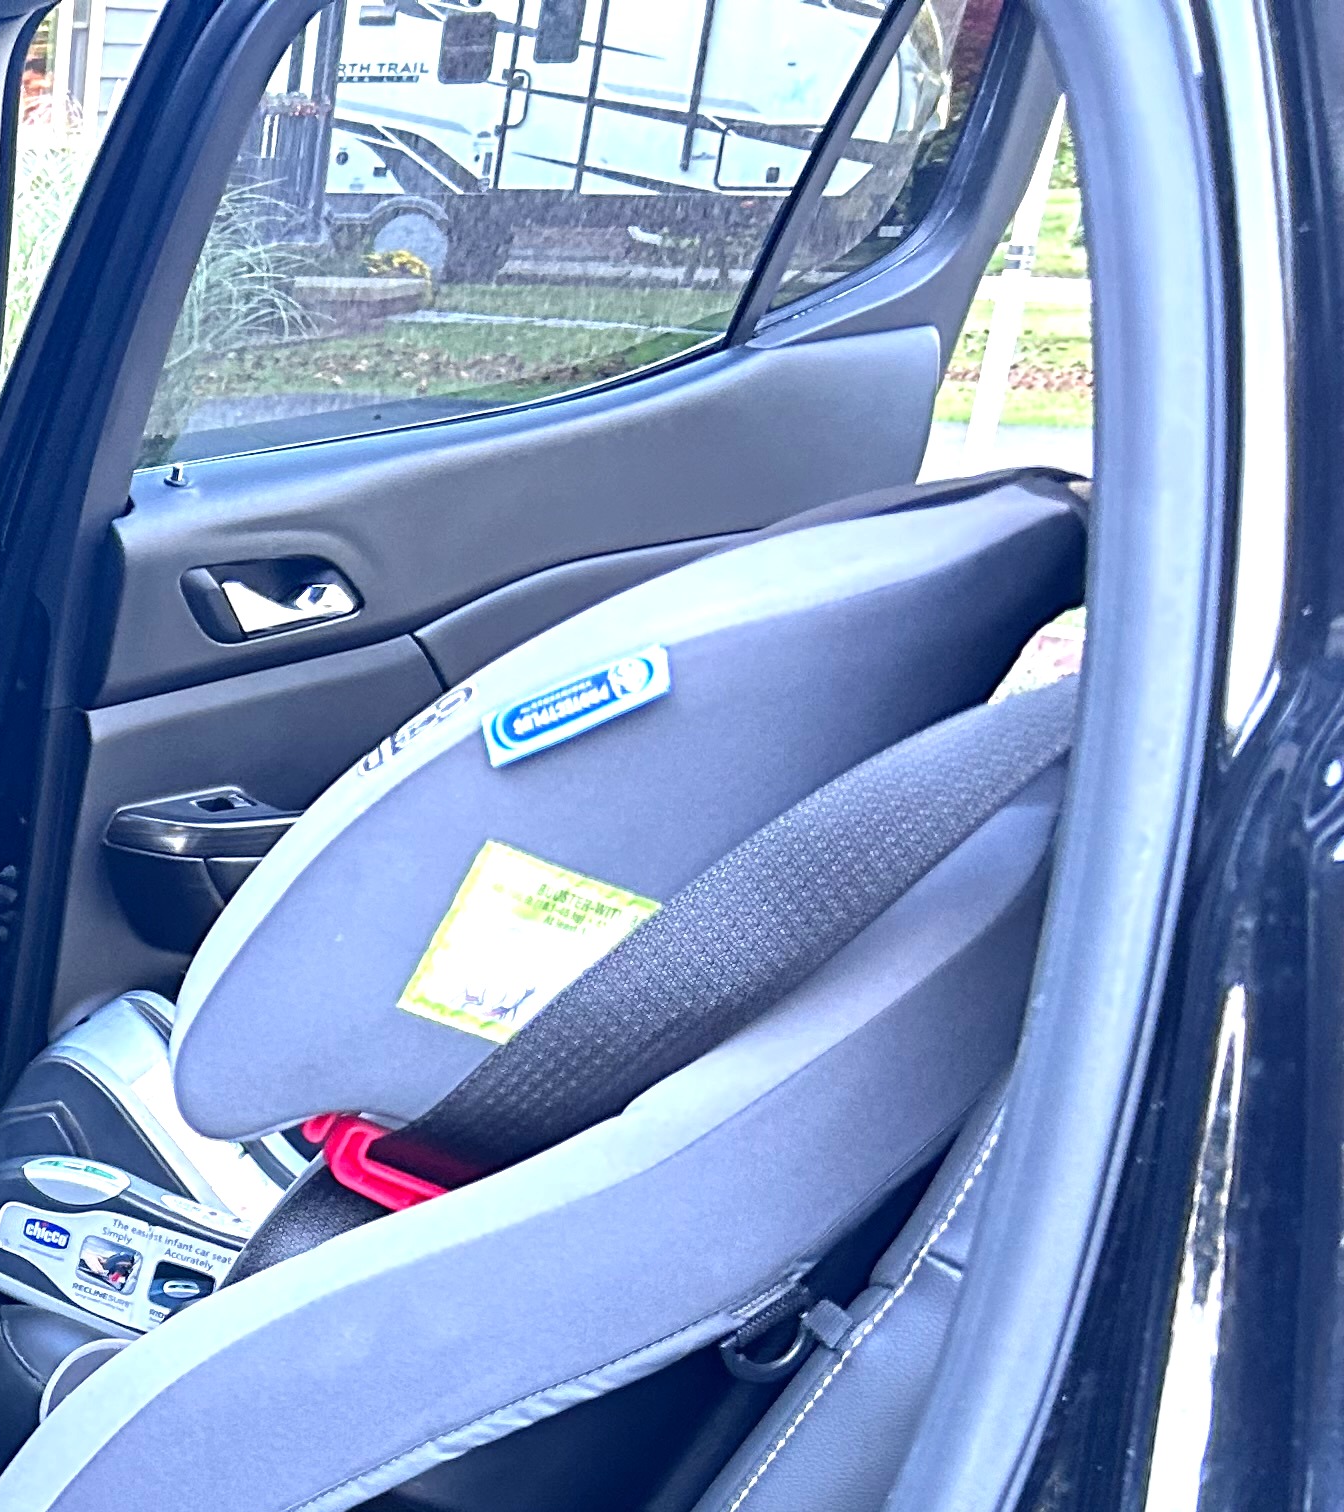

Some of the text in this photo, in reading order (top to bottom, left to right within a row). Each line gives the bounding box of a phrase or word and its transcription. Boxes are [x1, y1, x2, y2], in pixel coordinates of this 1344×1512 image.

[338, 62, 429, 74] RTH TRAIL
[25, 1221, 69, 1248] chicco
[102, 1226, 133, 1245] Simply
[113, 1218, 129, 1231] The
[164, 1237, 193, 1253] infant
[195, 1247, 210, 1257] car
[212, 1253, 232, 1265] seat
[164, 1247, 214, 1272] Accurately
